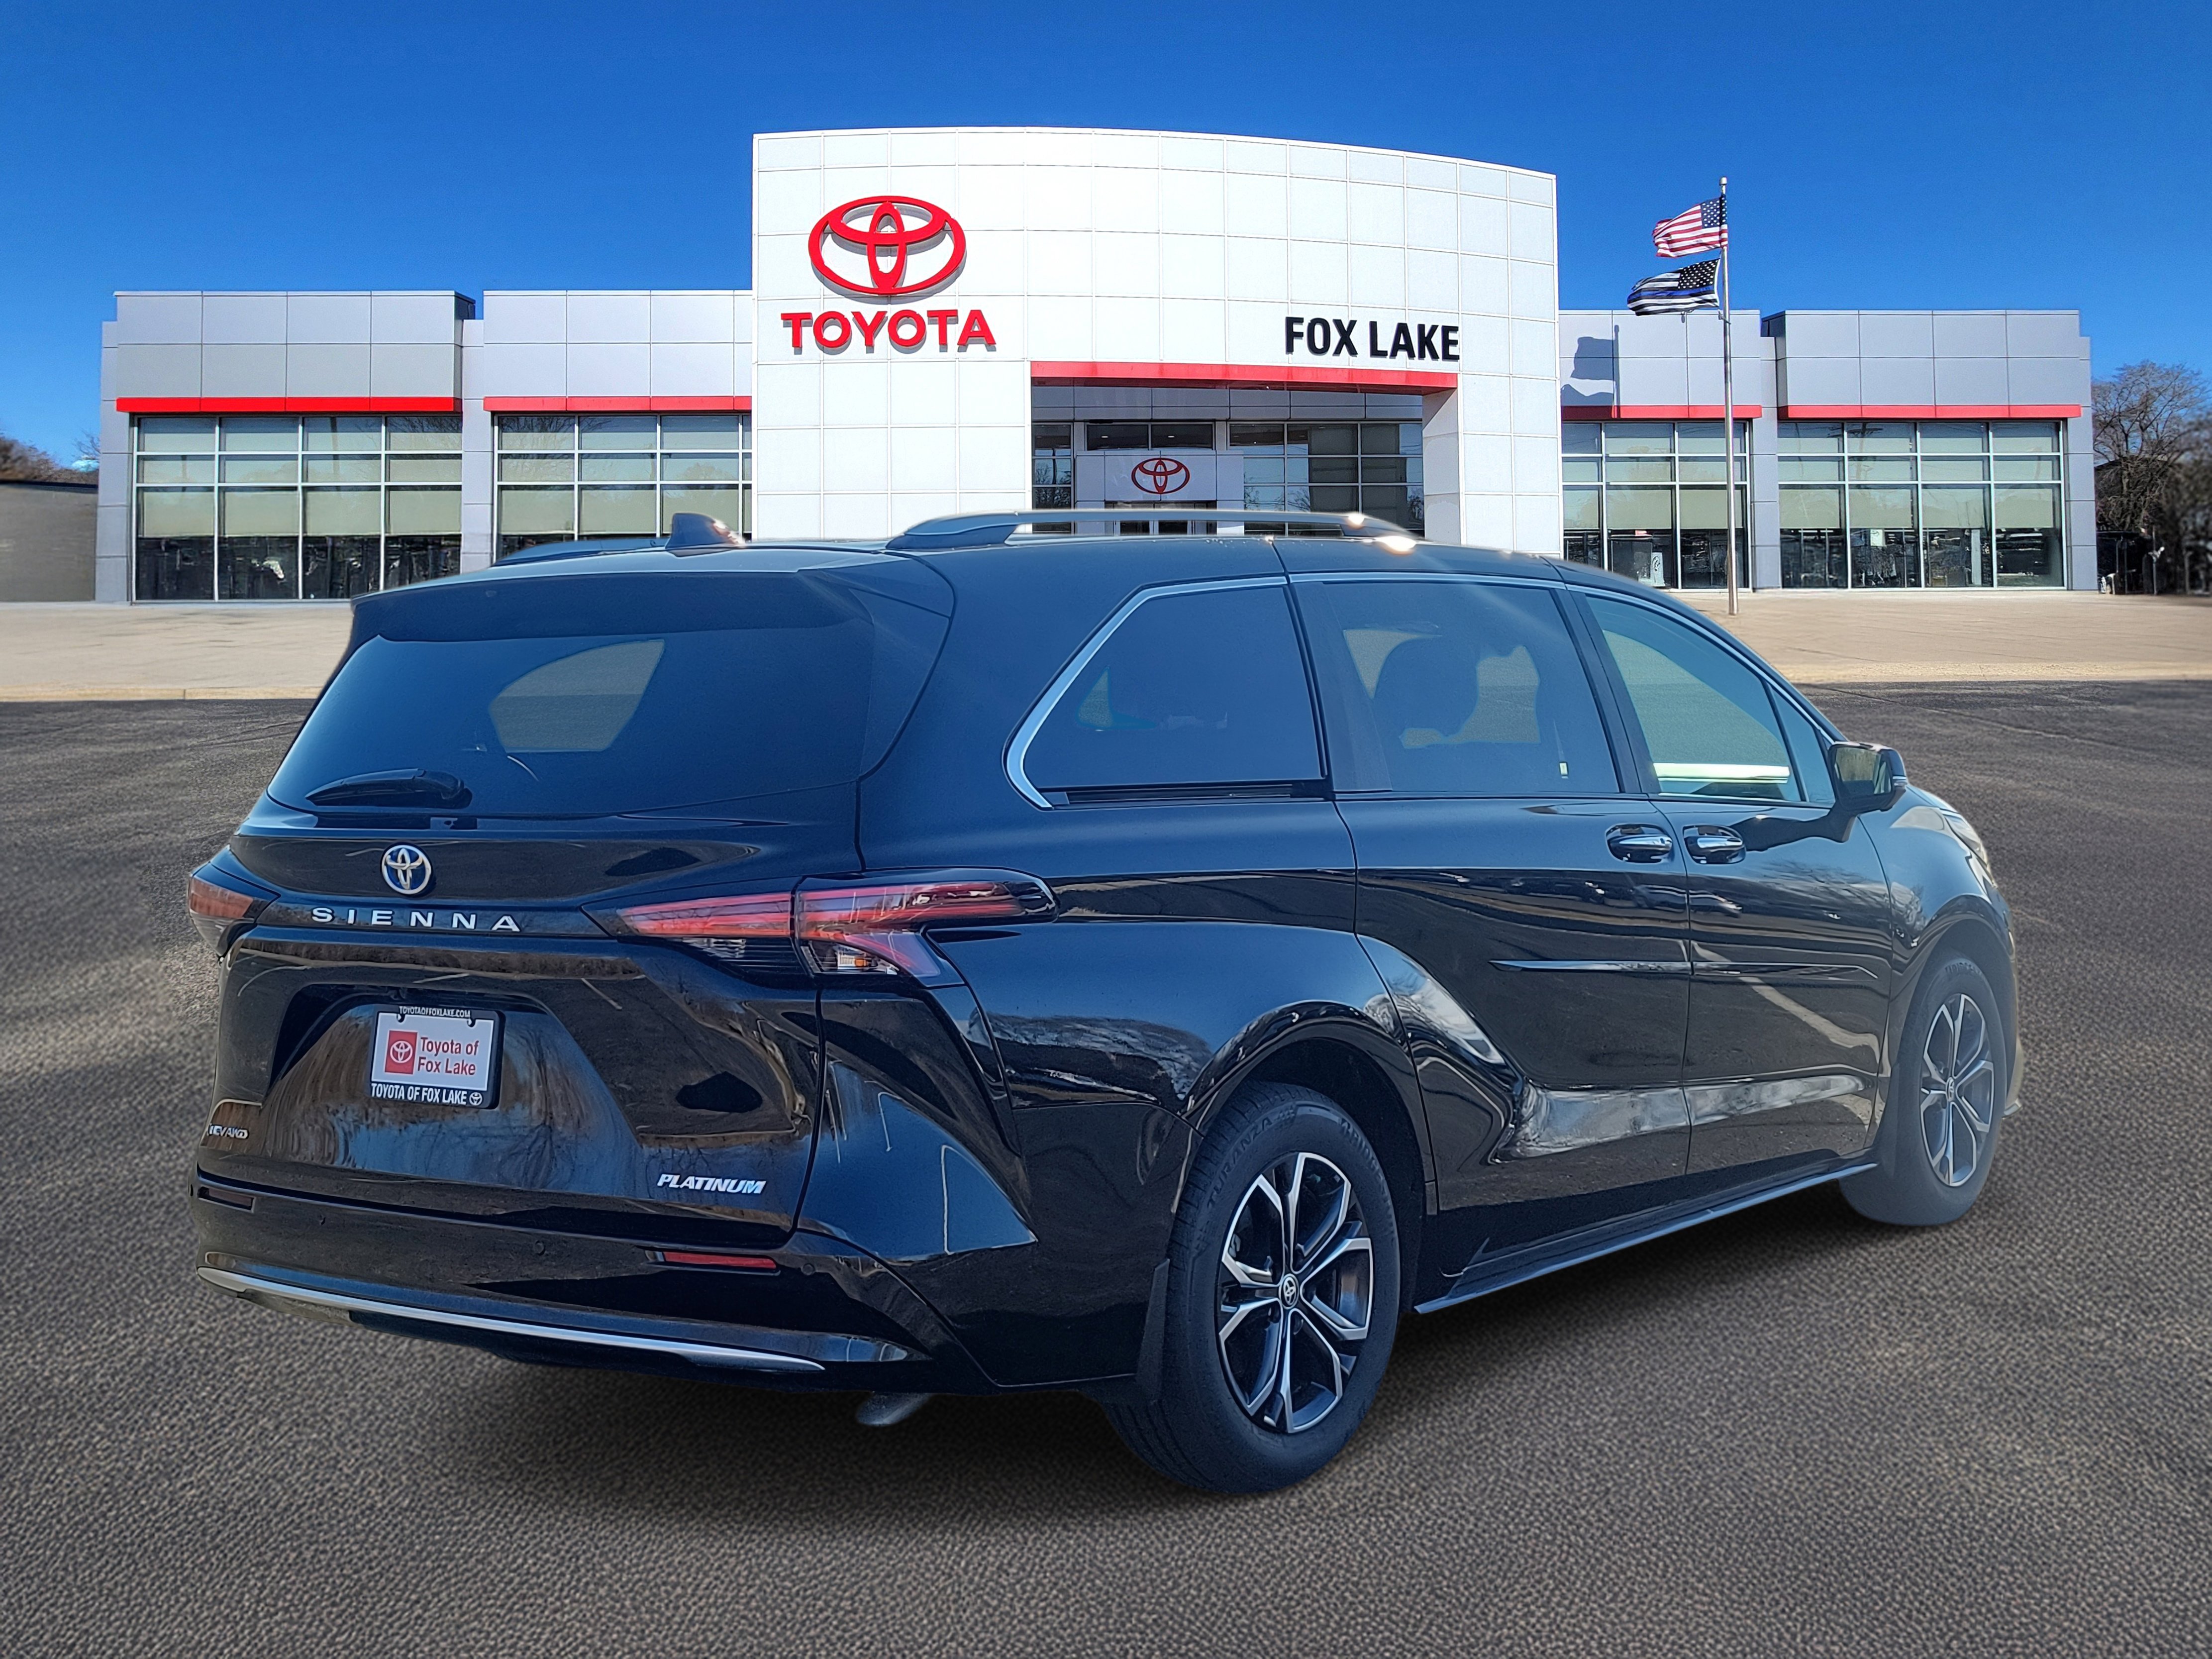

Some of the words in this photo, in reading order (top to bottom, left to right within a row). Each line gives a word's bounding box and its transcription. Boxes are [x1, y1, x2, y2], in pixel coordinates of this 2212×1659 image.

[781, 309, 997, 352] TOYOTA
[1285, 316, 1358, 357] FOX
[1369, 320, 1460, 361] LAKE
[311, 907, 520, 932] SIENNA
[420, 1037, 462, 1056] Toyota
[465, 1040, 479, 1055] of
[417, 1056, 441, 1073] Fox
[445, 1058, 476, 1075] Lake
[371, 1083, 405, 1100] TOYOTA
[407, 1086, 420, 1101] OF
[421, 1087, 442, 1103] FOX
[442, 1089, 467, 1105] LAKE
[657, 1173, 767, 1194] PLATINUM
